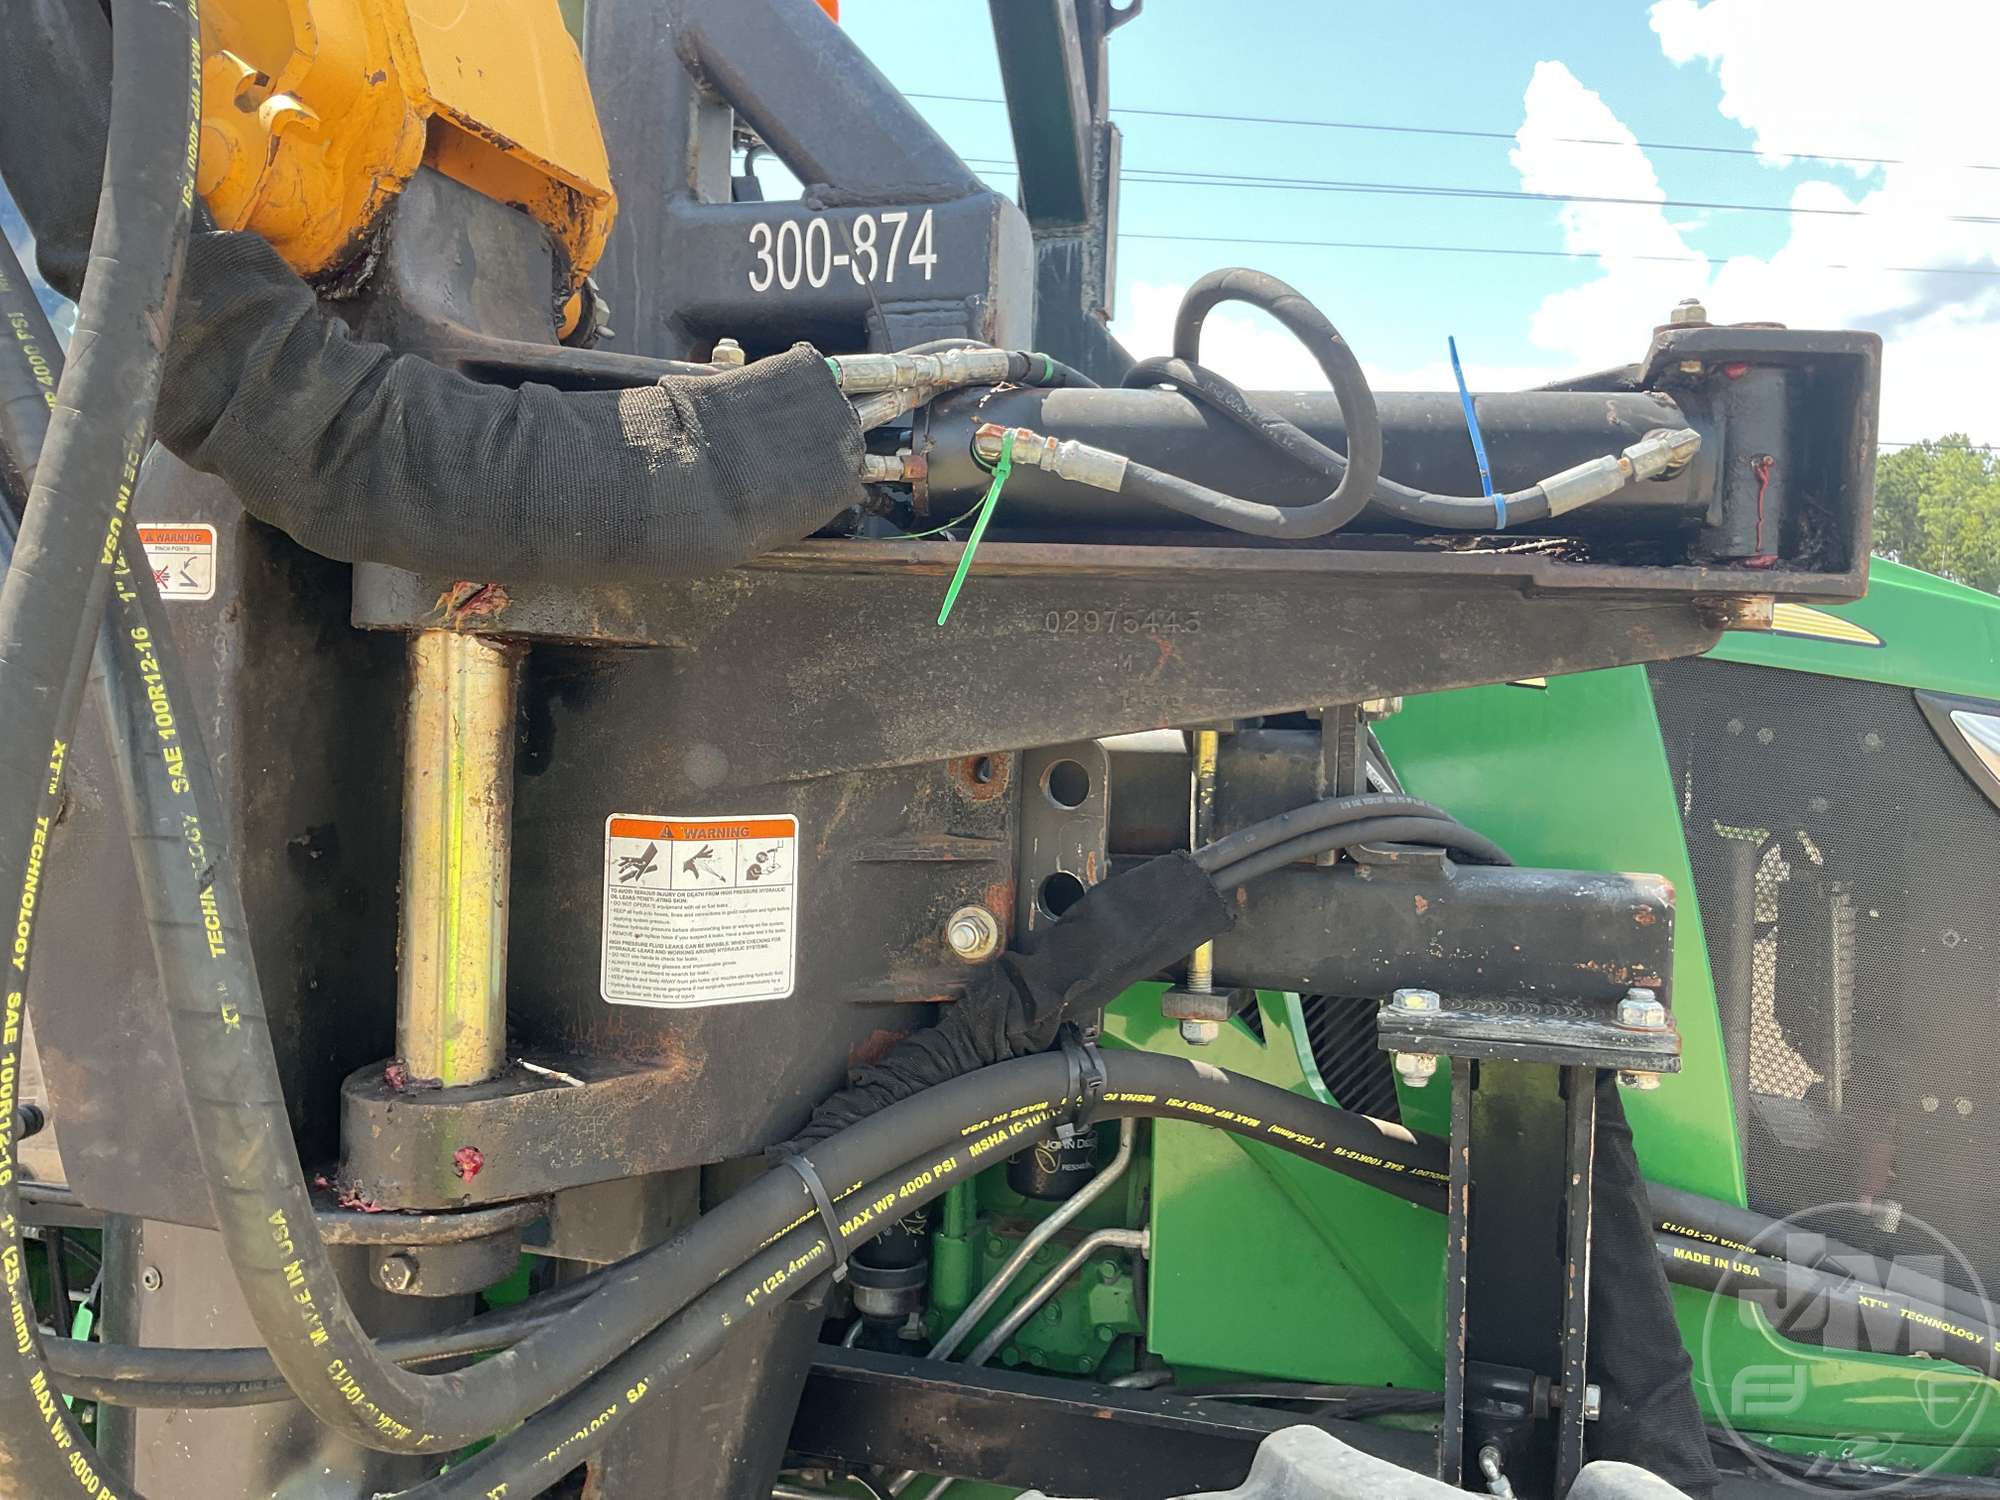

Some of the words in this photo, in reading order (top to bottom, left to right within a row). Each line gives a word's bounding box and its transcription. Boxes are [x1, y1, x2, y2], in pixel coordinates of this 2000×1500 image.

[191, 37, 200, 85] MAX
[748, 208, 937, 292] 300-874
[23, 344, 54, 386] 4000
[116, 484, 131, 514] IN
[101, 517, 123, 565] USA
[157, 533, 202, 542] WARNING
[130, 626, 176, 740] 100R12-16
[163, 745, 190, 794] SAE
[684, 826, 750, 839] WARNING
[12, 816, 50, 971] TECHNOLOGY
[3, 991, 22, 1045] SAE
[960, 1120, 990, 1136] USA
[992, 1113, 1009, 1124] IN
[1009, 1101, 1049, 1118] MADE
[1120, 1093, 1156, 1103] MSHA
[1165, 1098, 1188, 1109] PSI
[1186, 1101, 1217, 1115] 4000
[1215, 1109, 1236, 1120] WP
[1233, 1114, 1261, 1128] MAX
[1267, 1124, 1316, 1145] (25.4mm)
[1333, 1146, 1383, 1167] 100R12-16
[1382, 1160, 1406, 1173] SAE
[839, 1208, 874, 1238] MAX
[872, 1193, 897, 1214] WP
[899, 1171, 932, 1198] 4000
[932, 1157, 958, 1178] PSI
[968, 1129, 1009, 1158] MSHA
[1661, 1222, 1718, 1243] IC-101/13
[283, 1258, 305, 1289] IN
[1673, 1247, 1716, 1265] MADE
[1714, 1257, 1729, 1270] IN
[1732, 1261, 1762, 1278] USA
[1900, 1308, 1985, 1344] TECHNOLOGY
[30, 1369, 58, 1423] MAX
[50, 1415, 72, 1449] WP
[68, 1451, 99, 1494] 4000
